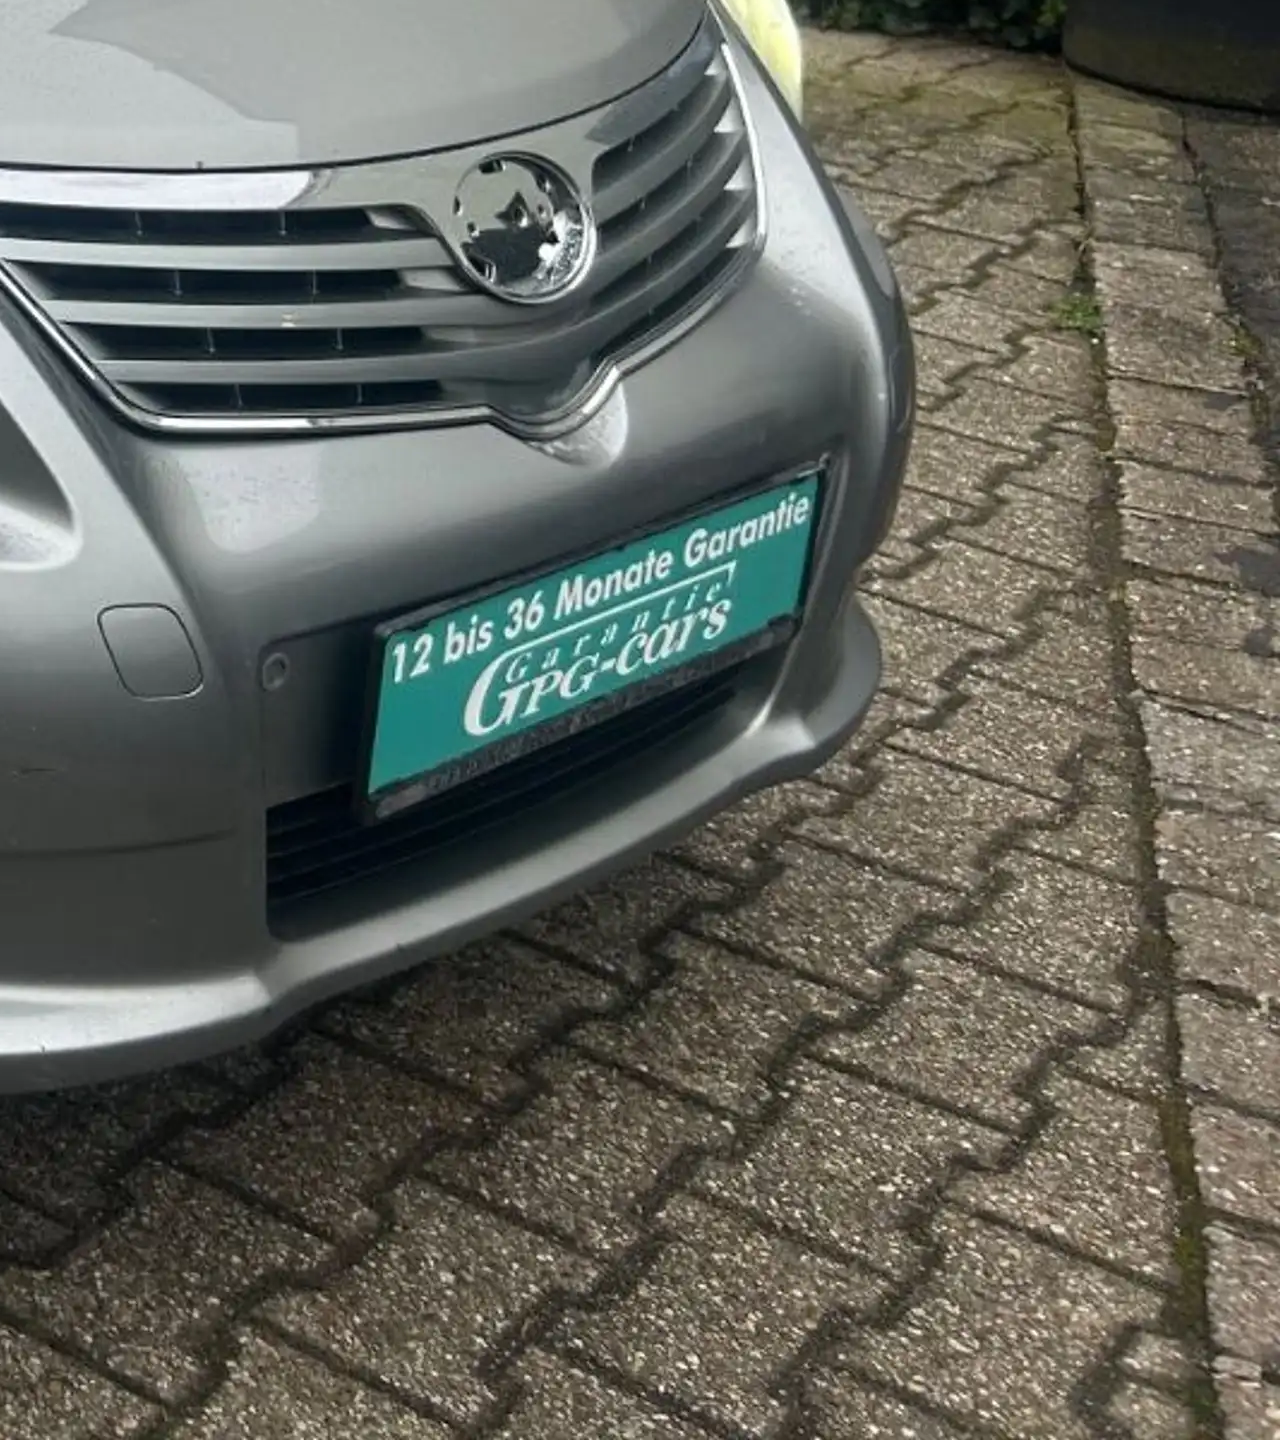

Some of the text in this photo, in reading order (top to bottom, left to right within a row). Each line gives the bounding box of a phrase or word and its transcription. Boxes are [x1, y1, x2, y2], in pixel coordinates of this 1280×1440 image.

[391, 491, 812, 685] 12 bis 36 Monate Garantie
[504, 580, 721, 684] Garantie
